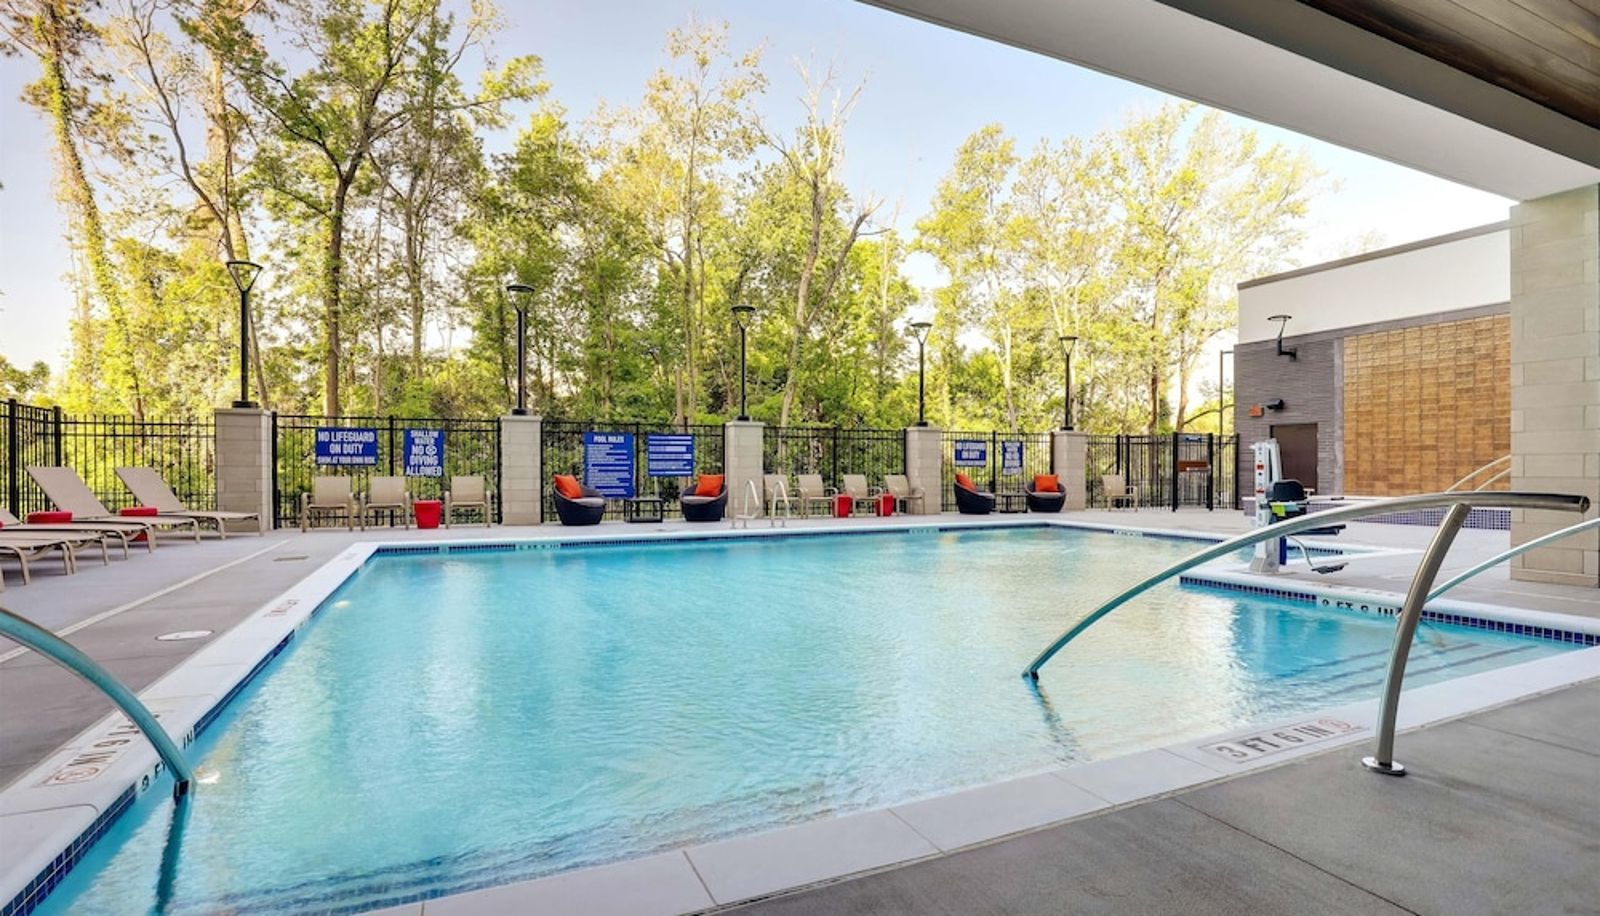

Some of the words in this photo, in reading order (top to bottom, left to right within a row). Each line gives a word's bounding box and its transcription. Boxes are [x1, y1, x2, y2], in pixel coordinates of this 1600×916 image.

[318, 431, 330, 442] NO
[331, 431, 375, 443] LIFEGUARD
[329, 443, 342, 454] ON
[343, 443, 364, 455] DUTY
[411, 445, 424, 455] NO
[409, 455, 439, 466] DIVING
[405, 465, 442, 476] ALLOWED
[183, 730, 193, 750] IN
[1215, 745, 1249, 759] 3
[1236, 736, 1281, 753] FT
[1272, 731, 1305, 743] 6
[1292, 724, 1336, 739] IN
